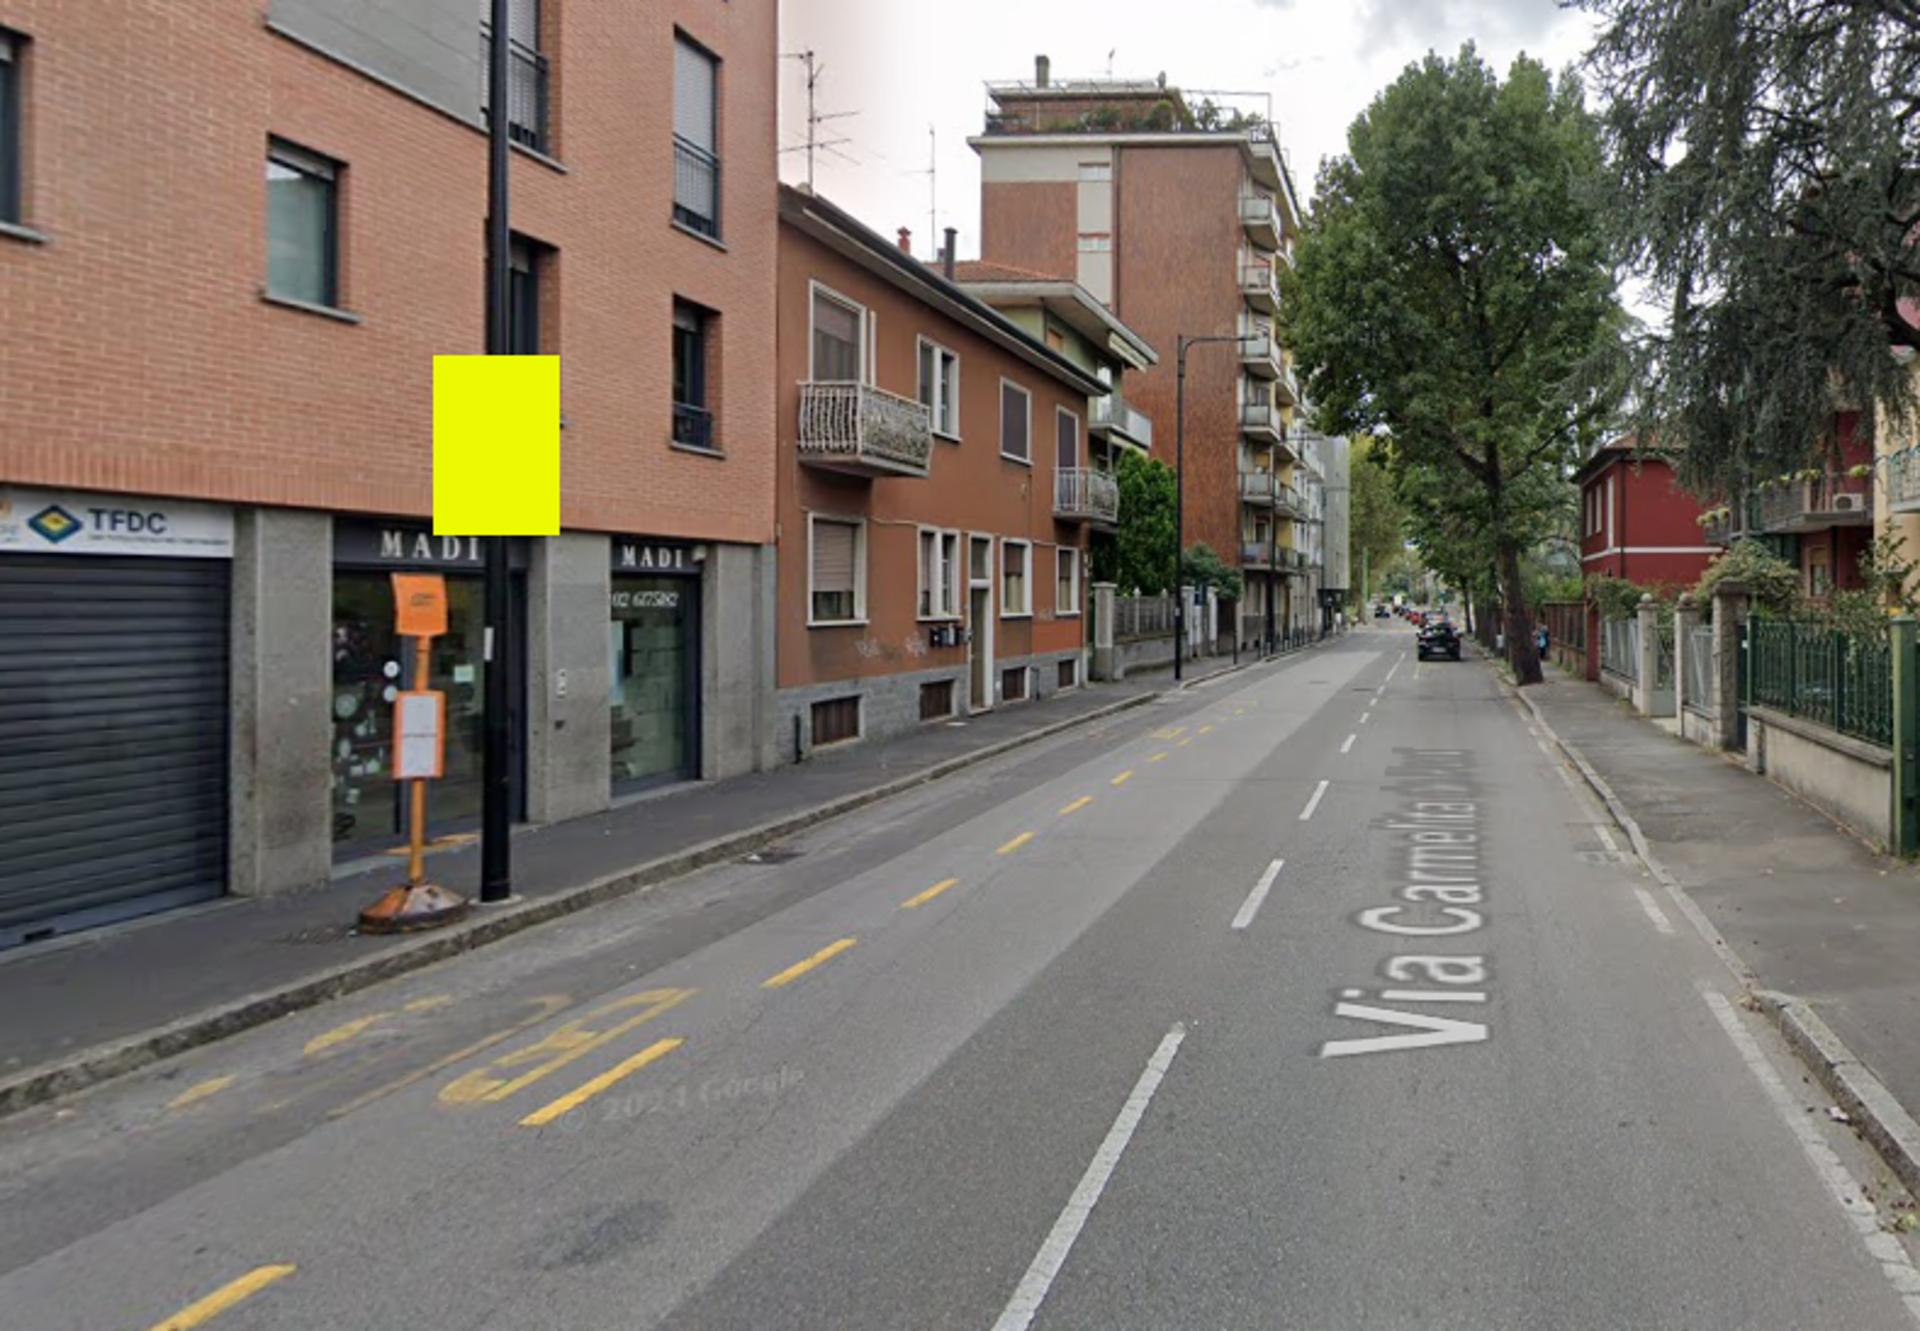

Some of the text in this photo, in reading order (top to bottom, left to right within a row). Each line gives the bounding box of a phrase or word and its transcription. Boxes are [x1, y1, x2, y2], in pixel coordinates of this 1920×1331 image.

[88, 507, 168, 535] TFDC
[380, 529, 480, 562] MADI
[621, 544, 684, 569] MADI
